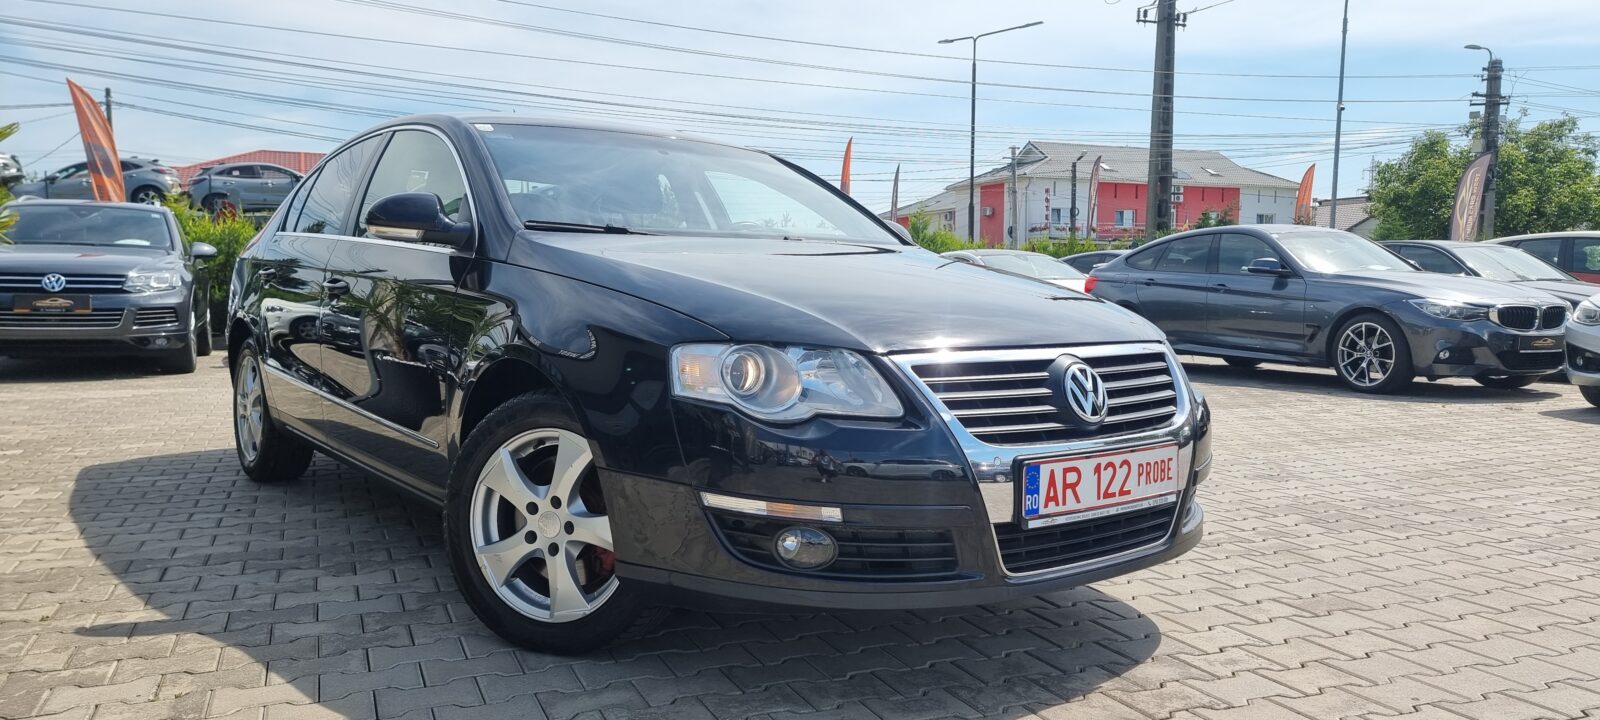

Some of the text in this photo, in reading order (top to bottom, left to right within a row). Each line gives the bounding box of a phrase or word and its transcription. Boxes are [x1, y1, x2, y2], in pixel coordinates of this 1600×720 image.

[1043, 457, 1173, 509] AR 122 PROBE
[1025, 494, 1039, 511] RO
